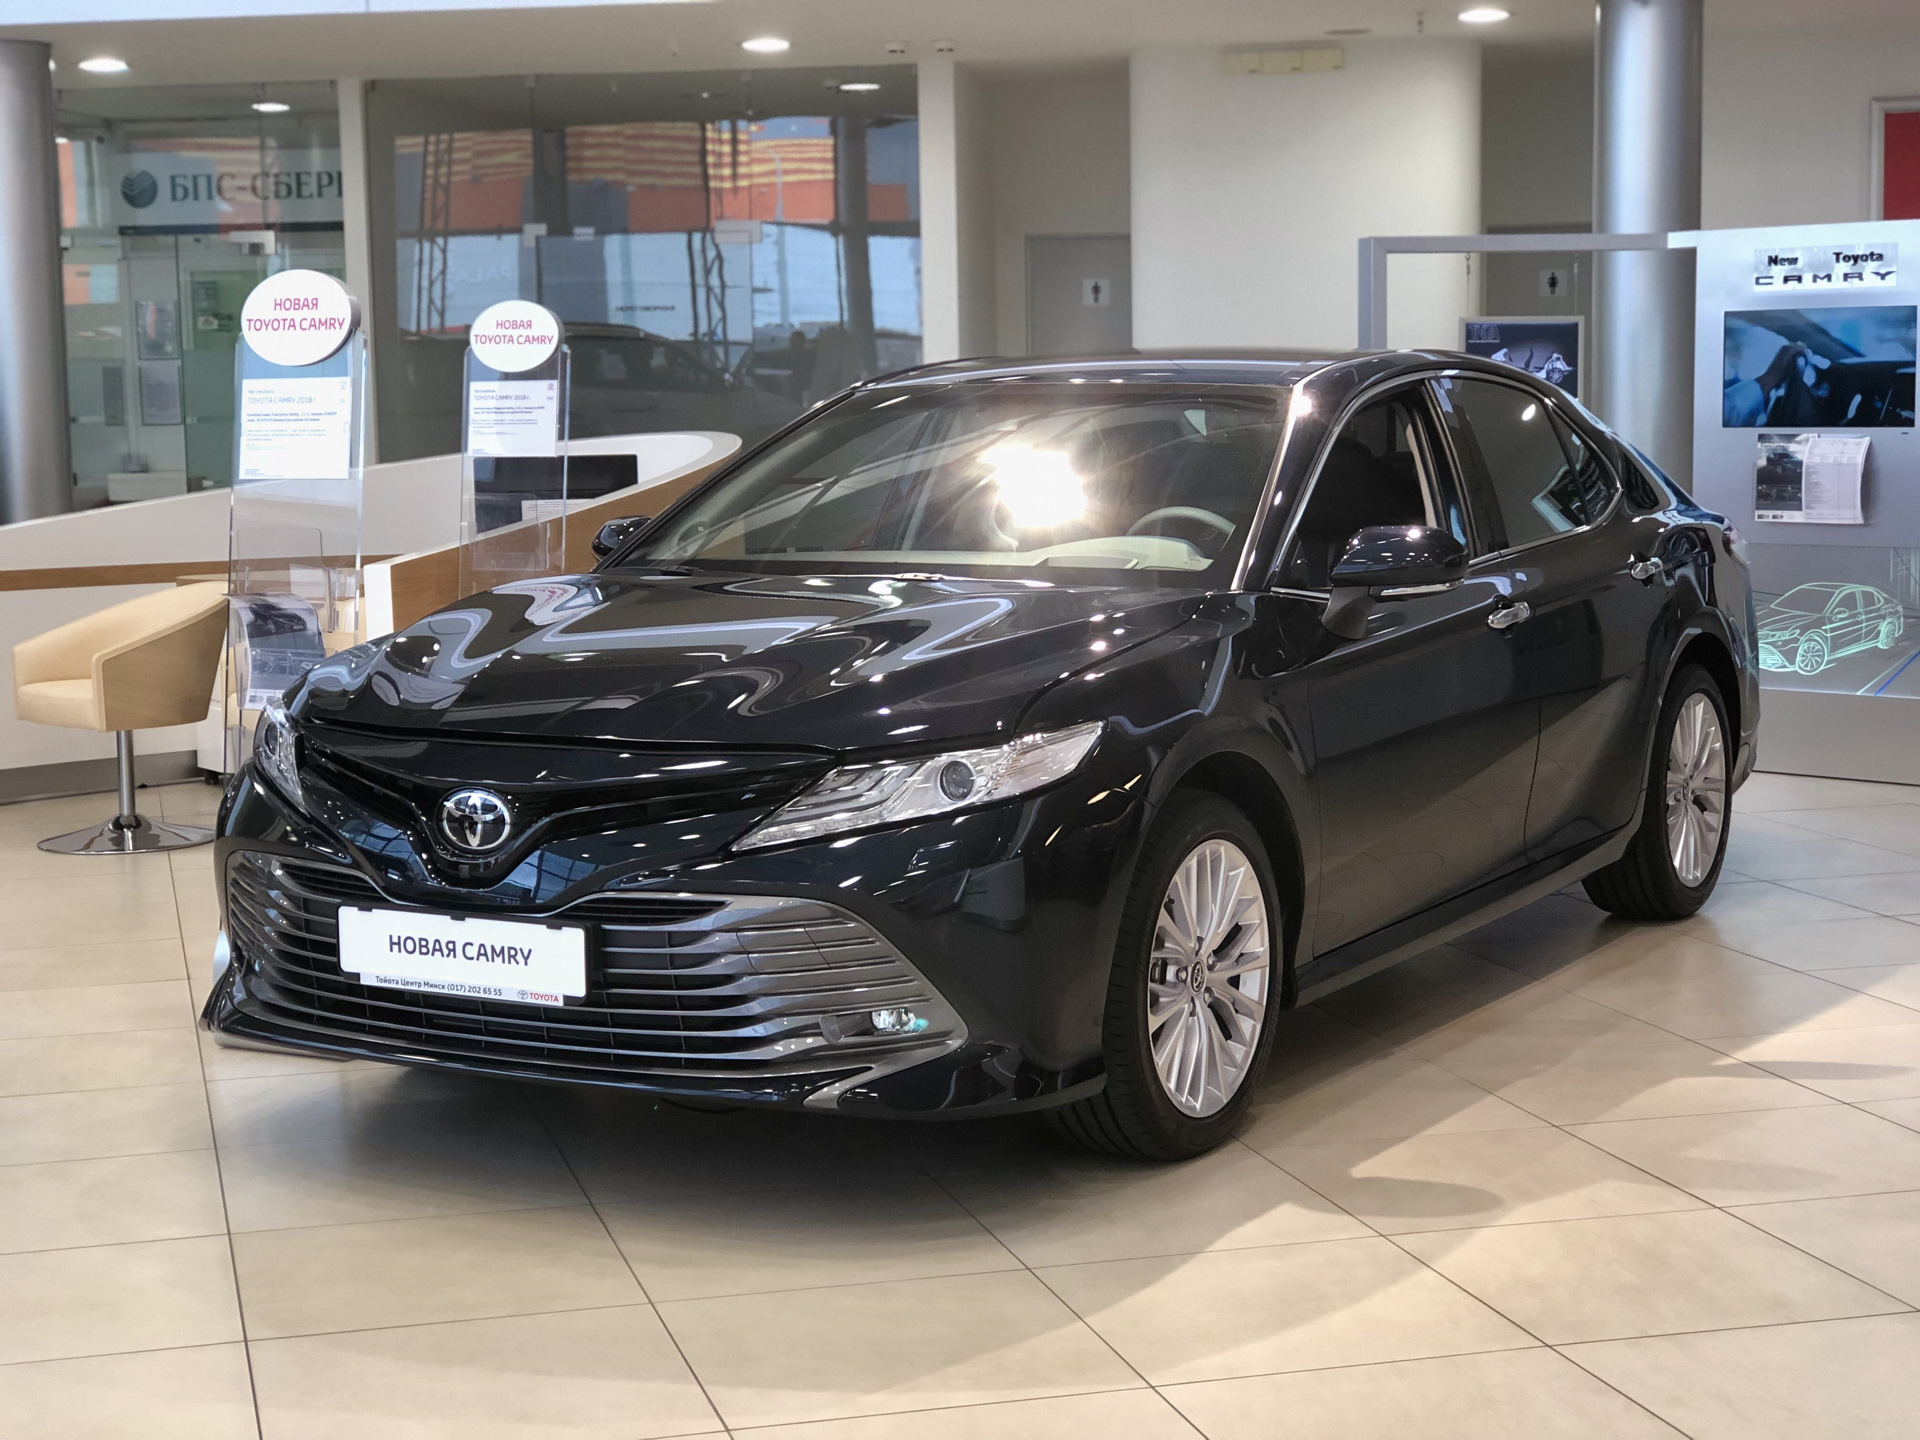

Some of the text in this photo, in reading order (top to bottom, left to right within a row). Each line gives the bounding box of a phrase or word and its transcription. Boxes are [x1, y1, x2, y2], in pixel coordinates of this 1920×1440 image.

[1767, 251, 1884, 266] New Toyota
[1755, 270, 1896, 286] CAMRY
[274, 297, 319, 311] НОВАЯ
[246, 318, 297, 332] TOYOTA
[299, 317, 345, 331] CAMRY
[495, 319, 533, 330] НОВАЯ
[473, 334, 554, 345] TOYOTA CAMRY
[273, 396, 296, 404] CAMRY
[296, 396, 313, 404] 2018
[388, 934, 533, 967] НОВАЯ CAMRY
[375, 975, 503, 997] Тойота Центр Минск (017) 202 65 55
[529, 992, 560, 1003] TOYOTA
